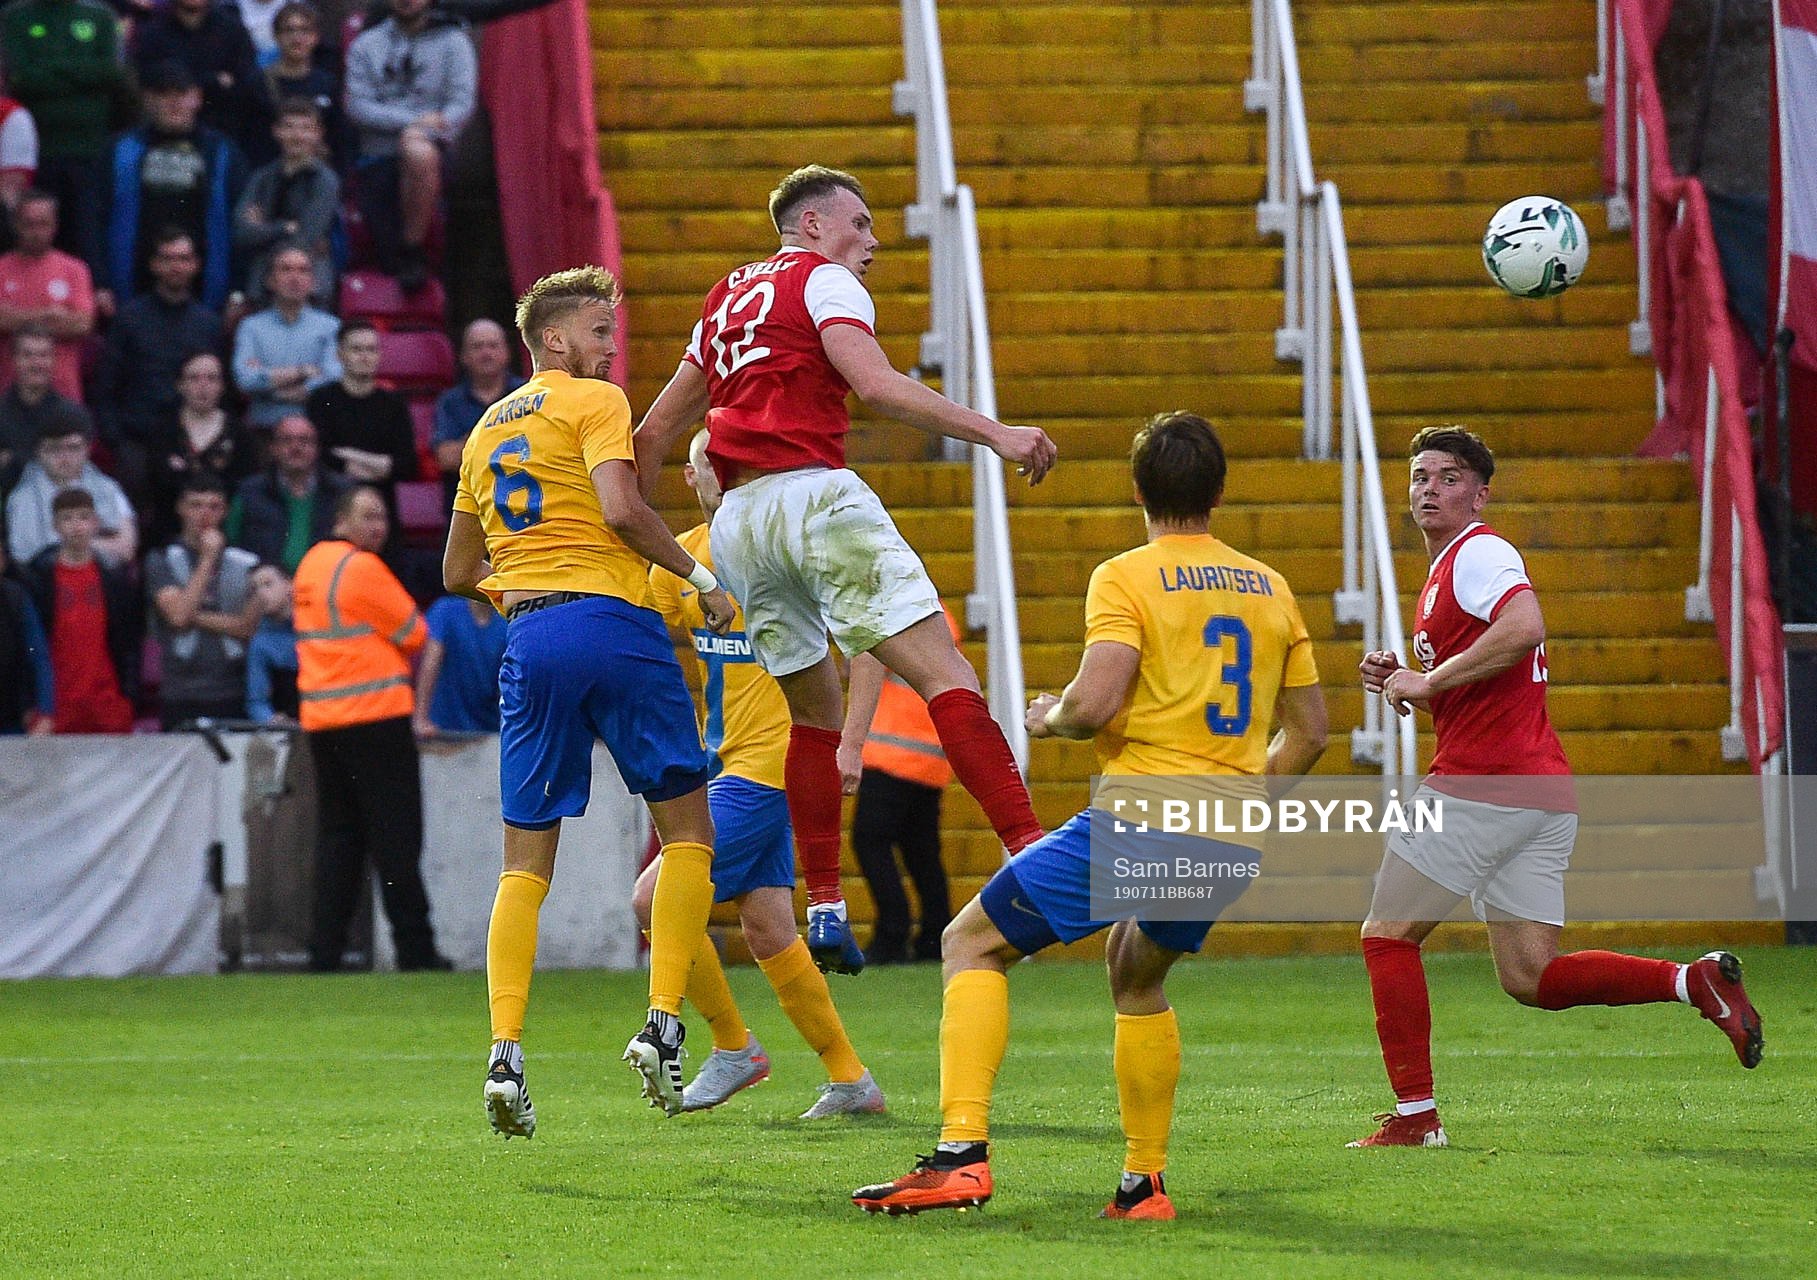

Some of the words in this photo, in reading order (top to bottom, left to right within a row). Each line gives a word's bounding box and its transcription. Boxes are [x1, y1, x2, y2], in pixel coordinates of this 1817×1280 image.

[710, 280, 776, 379] 12
[485, 392, 546, 429] LARSEN
[489, 433, 543, 532] 6
[1160, 566, 1274, 596] LAURITSEN
[695, 636, 751, 655] OLMEN
[1203, 615, 1252, 737] 3
